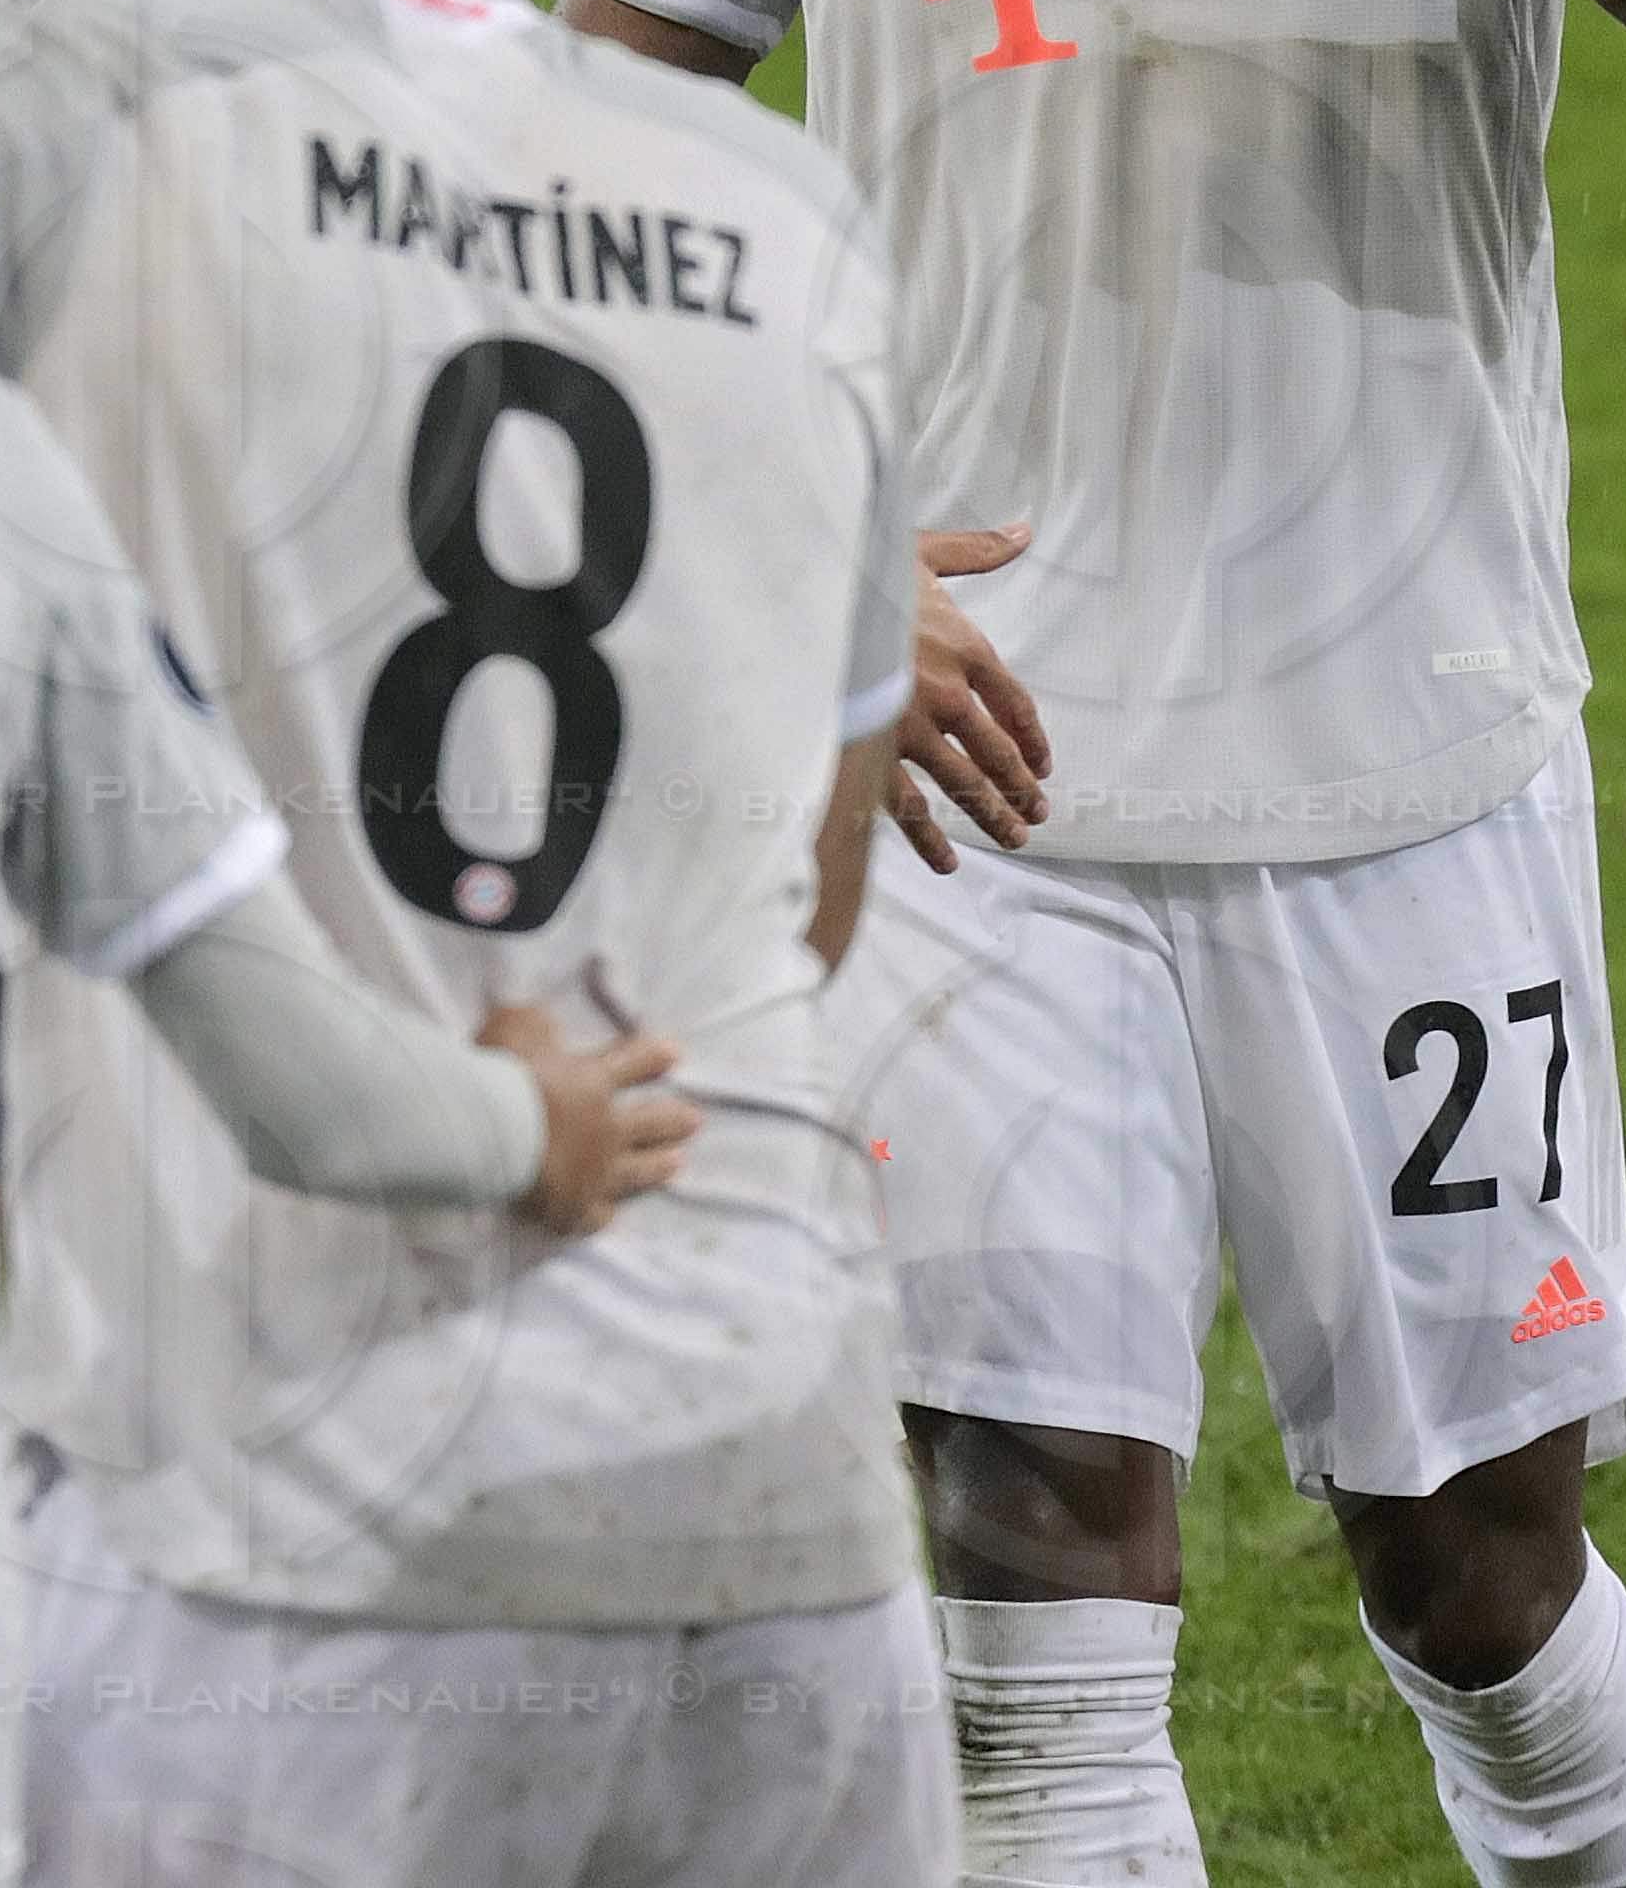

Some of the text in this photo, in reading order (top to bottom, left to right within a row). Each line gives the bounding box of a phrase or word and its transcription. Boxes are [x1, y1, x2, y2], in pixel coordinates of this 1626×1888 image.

[357, 336, 653, 934] 8
[1383, 979, 1570, 1219] 27
[1510, 1298, 1606, 1344] adidas
